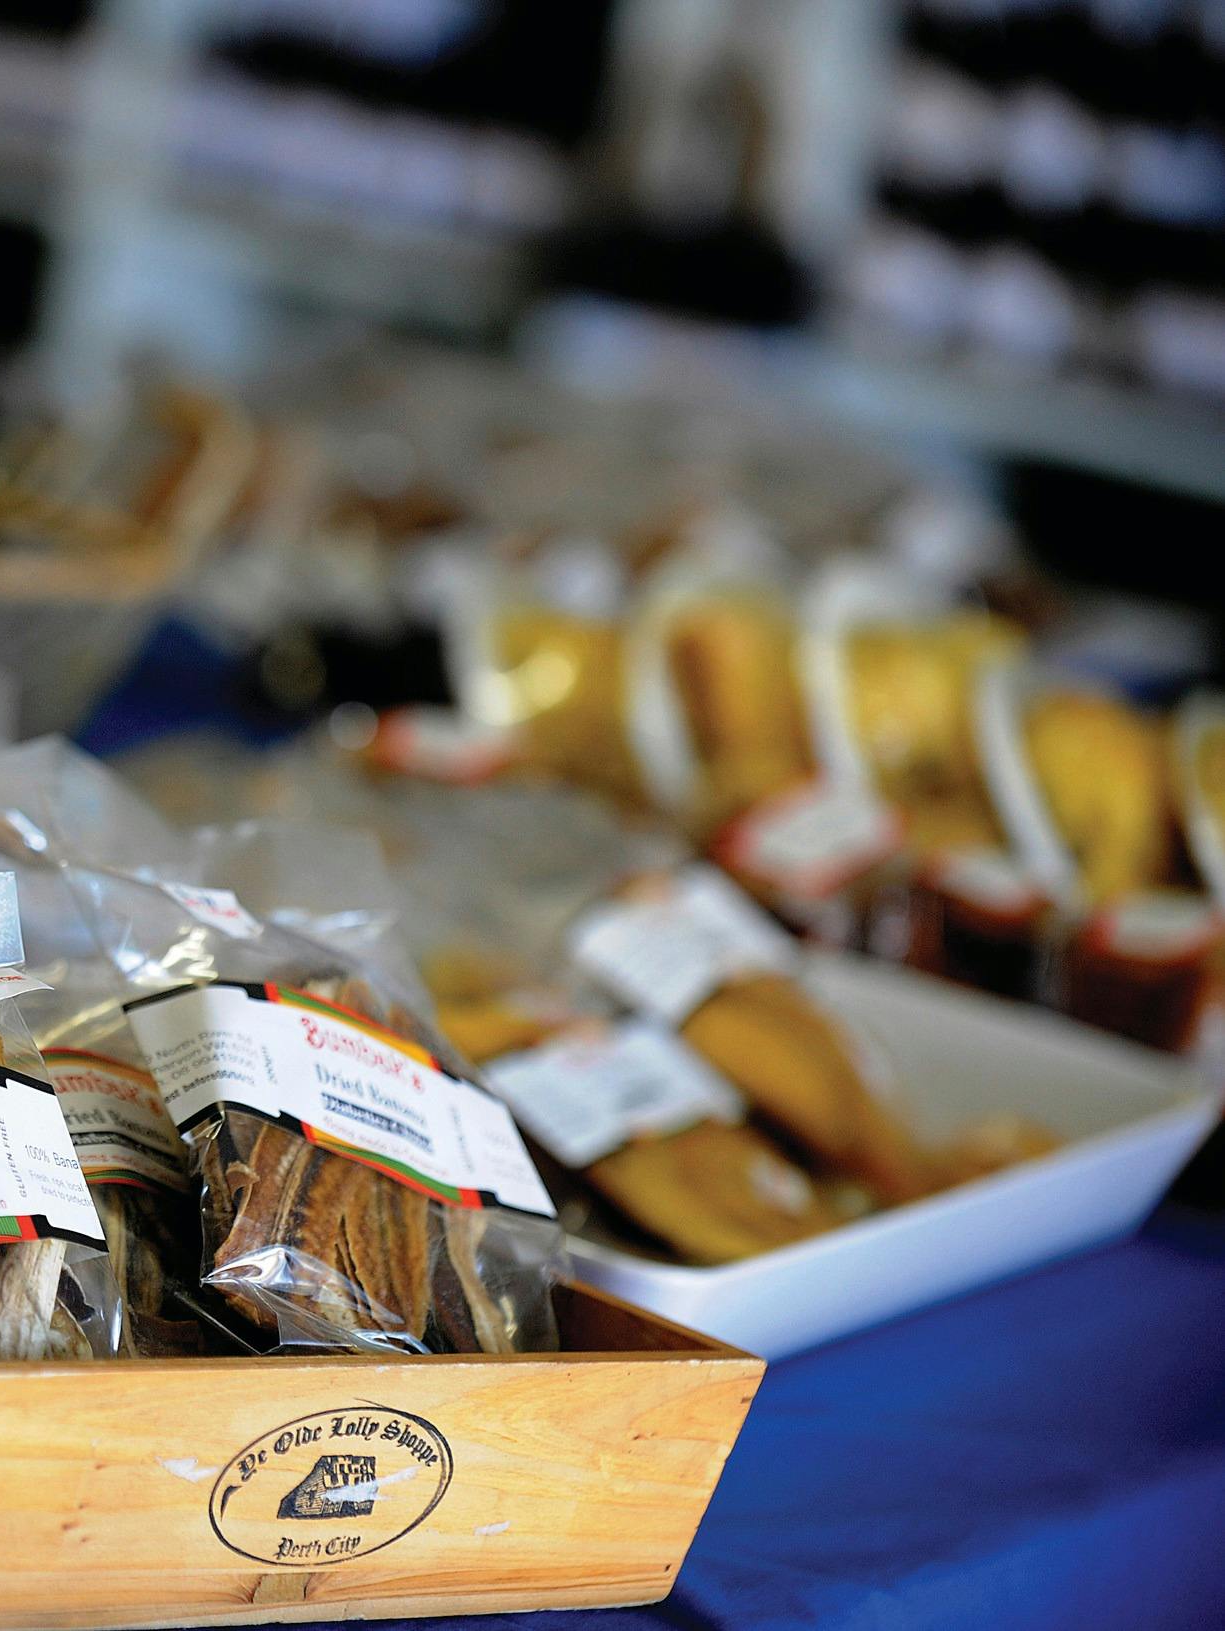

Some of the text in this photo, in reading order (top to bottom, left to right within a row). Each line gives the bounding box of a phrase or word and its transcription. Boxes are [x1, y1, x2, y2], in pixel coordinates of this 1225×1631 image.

[6, 1152, 28, 1199] GLUTEN
[274, 1425, 323, 1455] Olde
[328, 1416, 380, 1441] Lolly
[379, 1418, 439, 1468] Shoppe
[273, 1534, 362, 1561] Perth City
